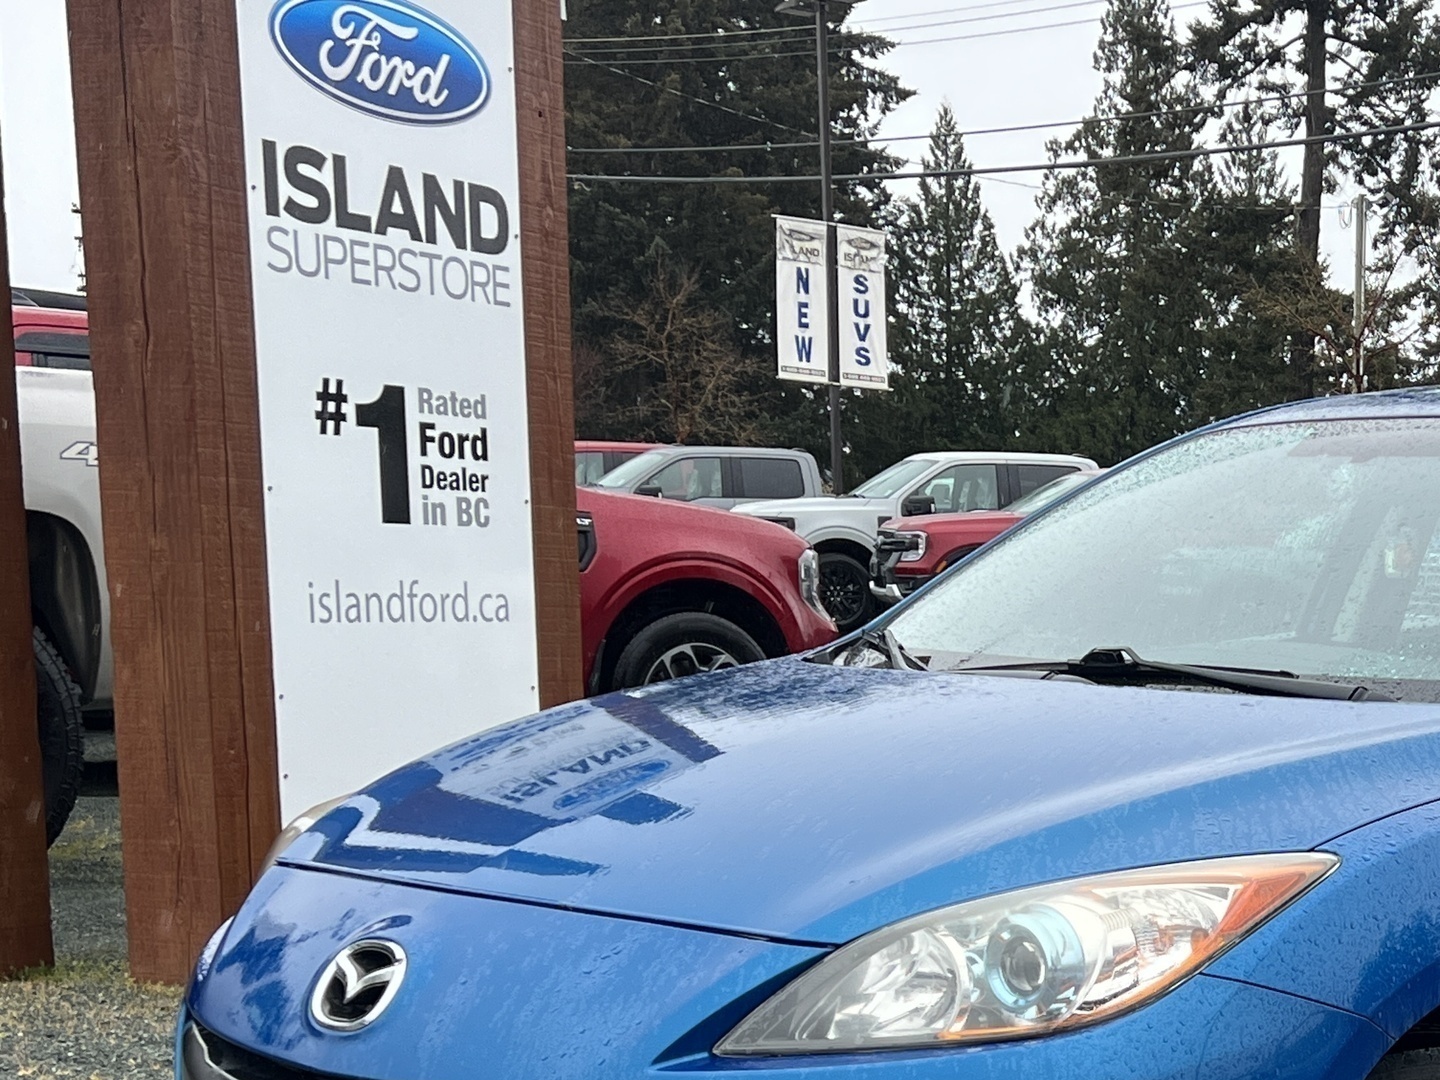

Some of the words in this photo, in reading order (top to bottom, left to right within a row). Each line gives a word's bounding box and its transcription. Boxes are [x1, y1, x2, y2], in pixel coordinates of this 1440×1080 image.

[319, 5, 450, 107] Ford
[262, 138, 509, 255] ISLAND
[266, 225, 511, 307] SUPERSTORE
[795, 266, 812, 363] NEW
[852, 274, 871, 366] SUVS
[418, 387, 487, 420] Rated
[60, 441, 98, 467] 4
[315, 378, 411, 525] #1
[419, 421, 489, 462] Ford
[420, 464, 489, 493] Dealer
[422, 494, 447, 526] in
[456, 496, 490, 528] BC
[308, 579, 510, 624] islandford.ca
